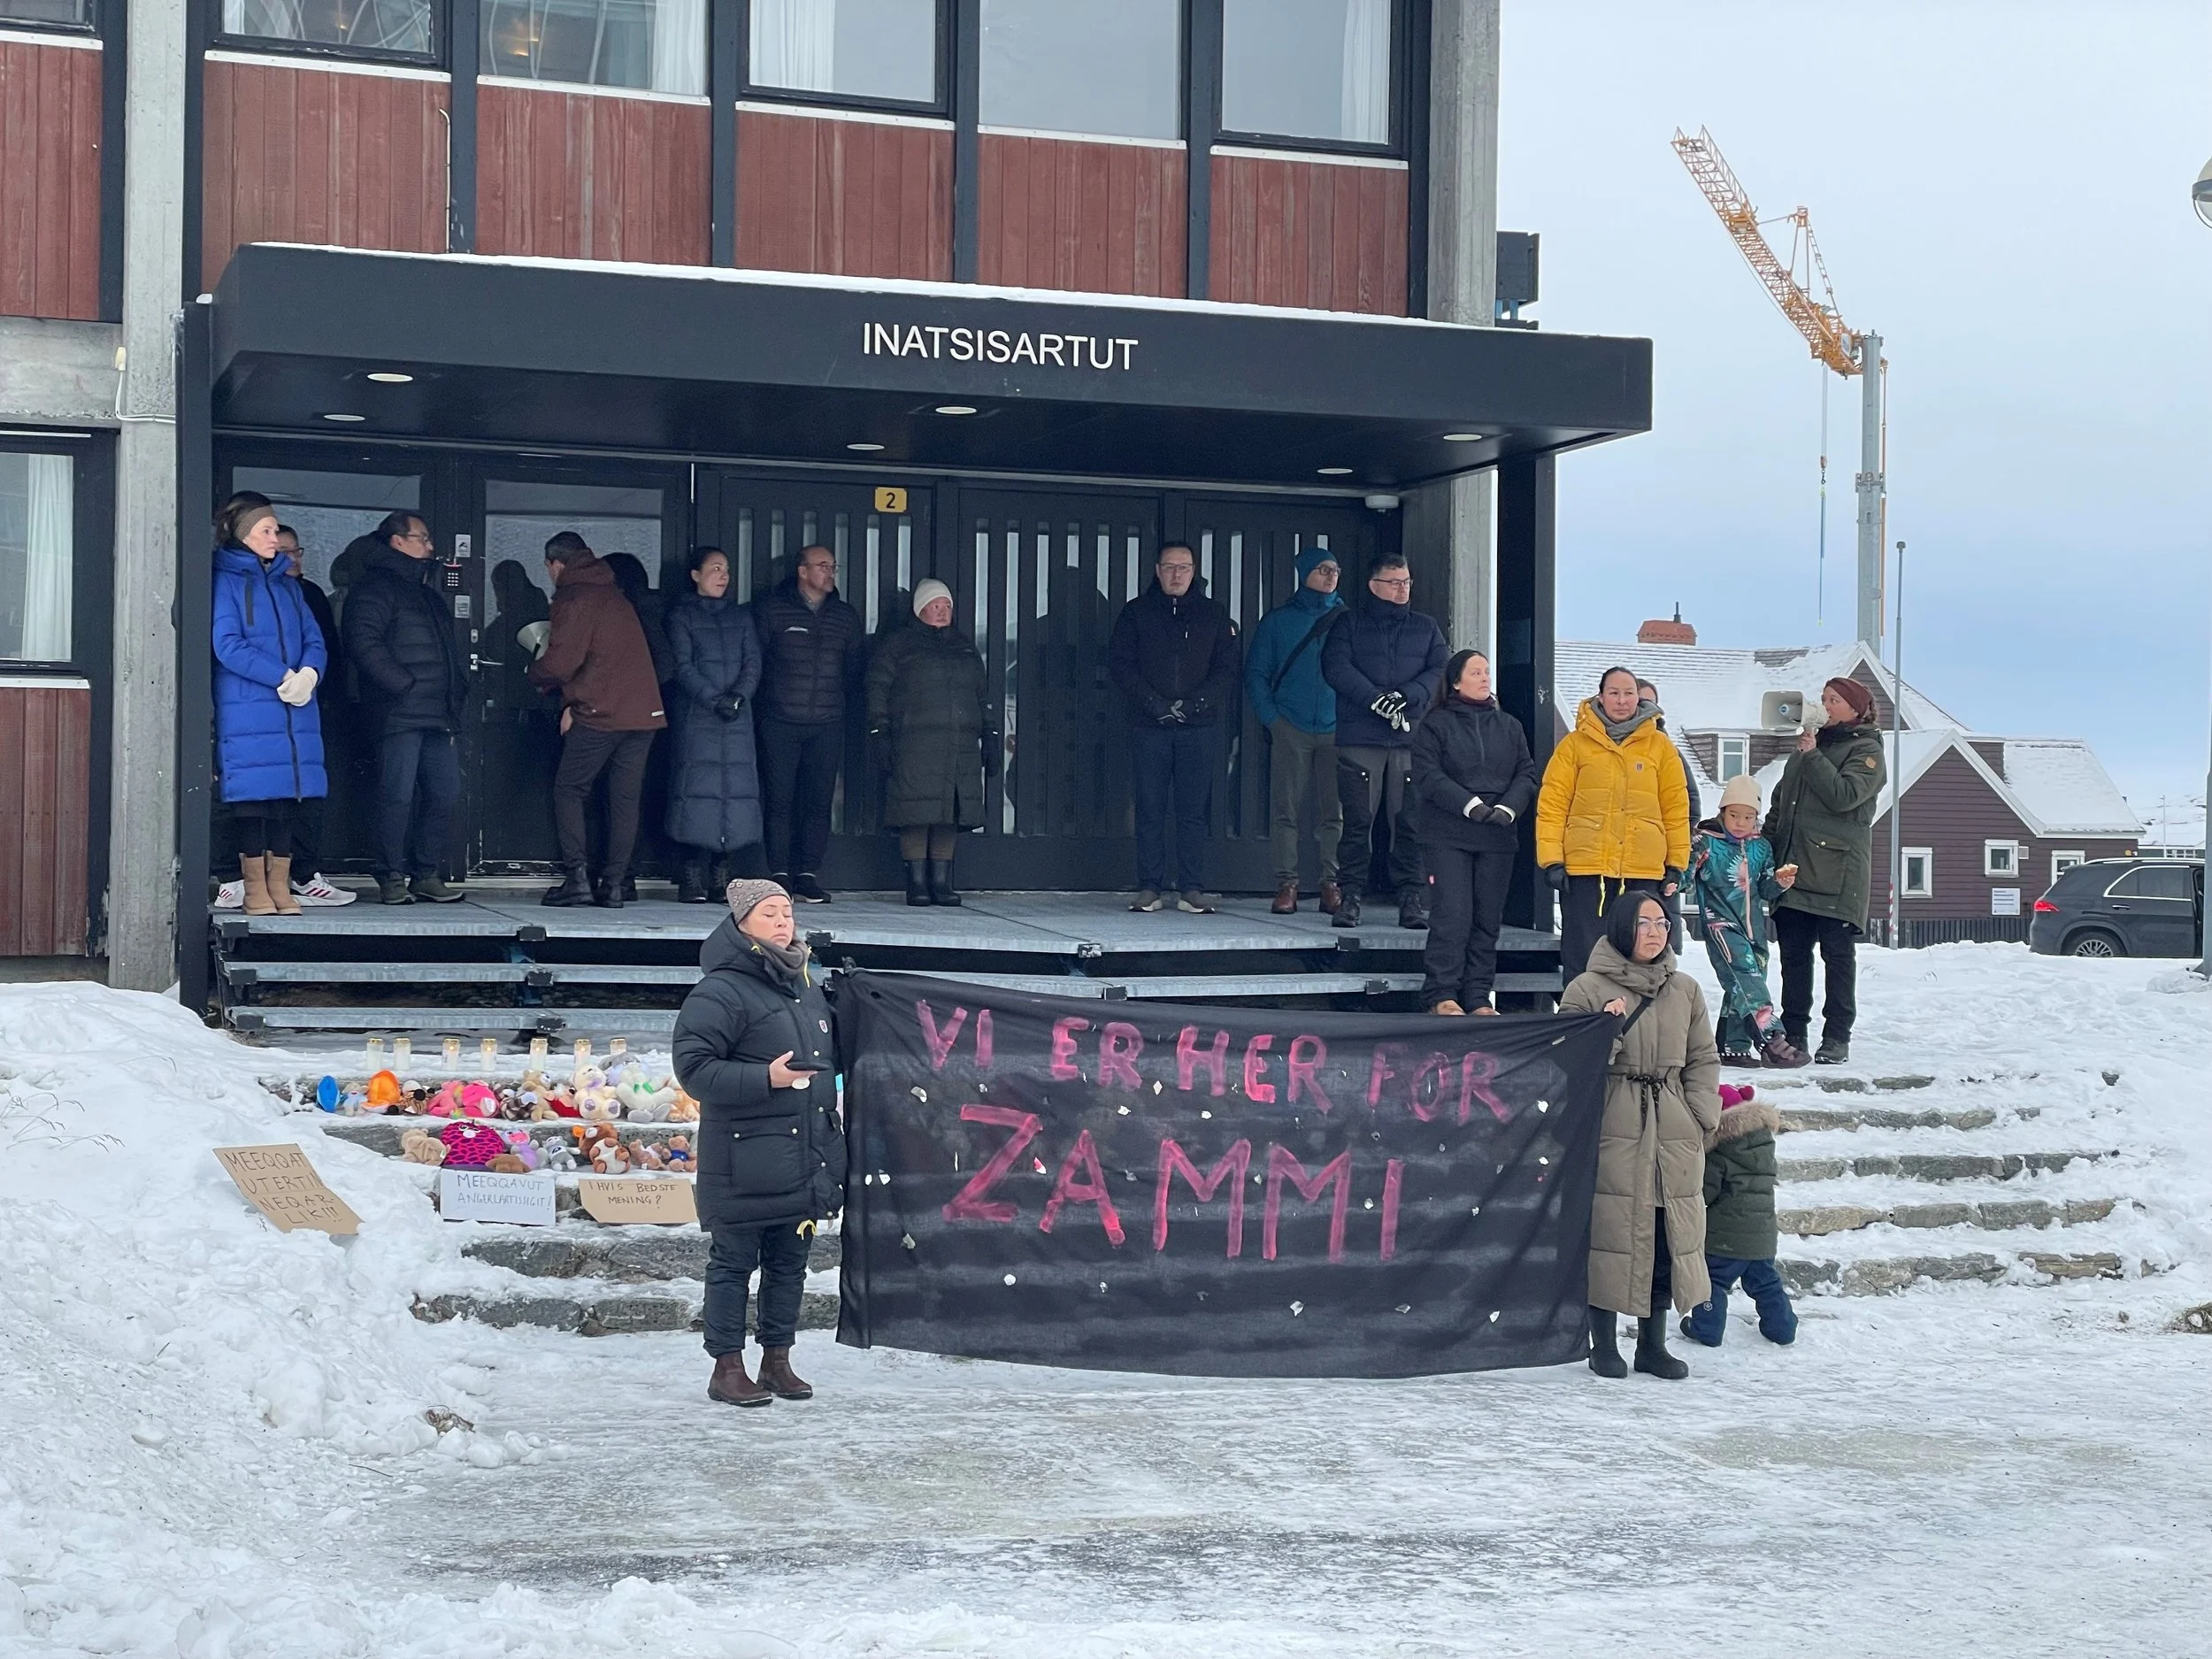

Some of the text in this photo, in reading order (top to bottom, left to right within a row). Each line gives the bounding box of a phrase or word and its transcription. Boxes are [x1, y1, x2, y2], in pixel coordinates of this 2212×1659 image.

[863, 322, 1139, 371] INATSISARTUT
[885, 493, 896, 510] 2
[917, 999, 1514, 1126] VI ER HER FOR
[224, 1151, 306, 1173] MEEQQAT
[457, 1173, 544, 1191] MEEQQAVUT
[596, 1181, 624, 1191] HVIS
[636, 1182, 678, 1193] BEDSTE
[942, 1103, 1403, 1263] ZAMMI
